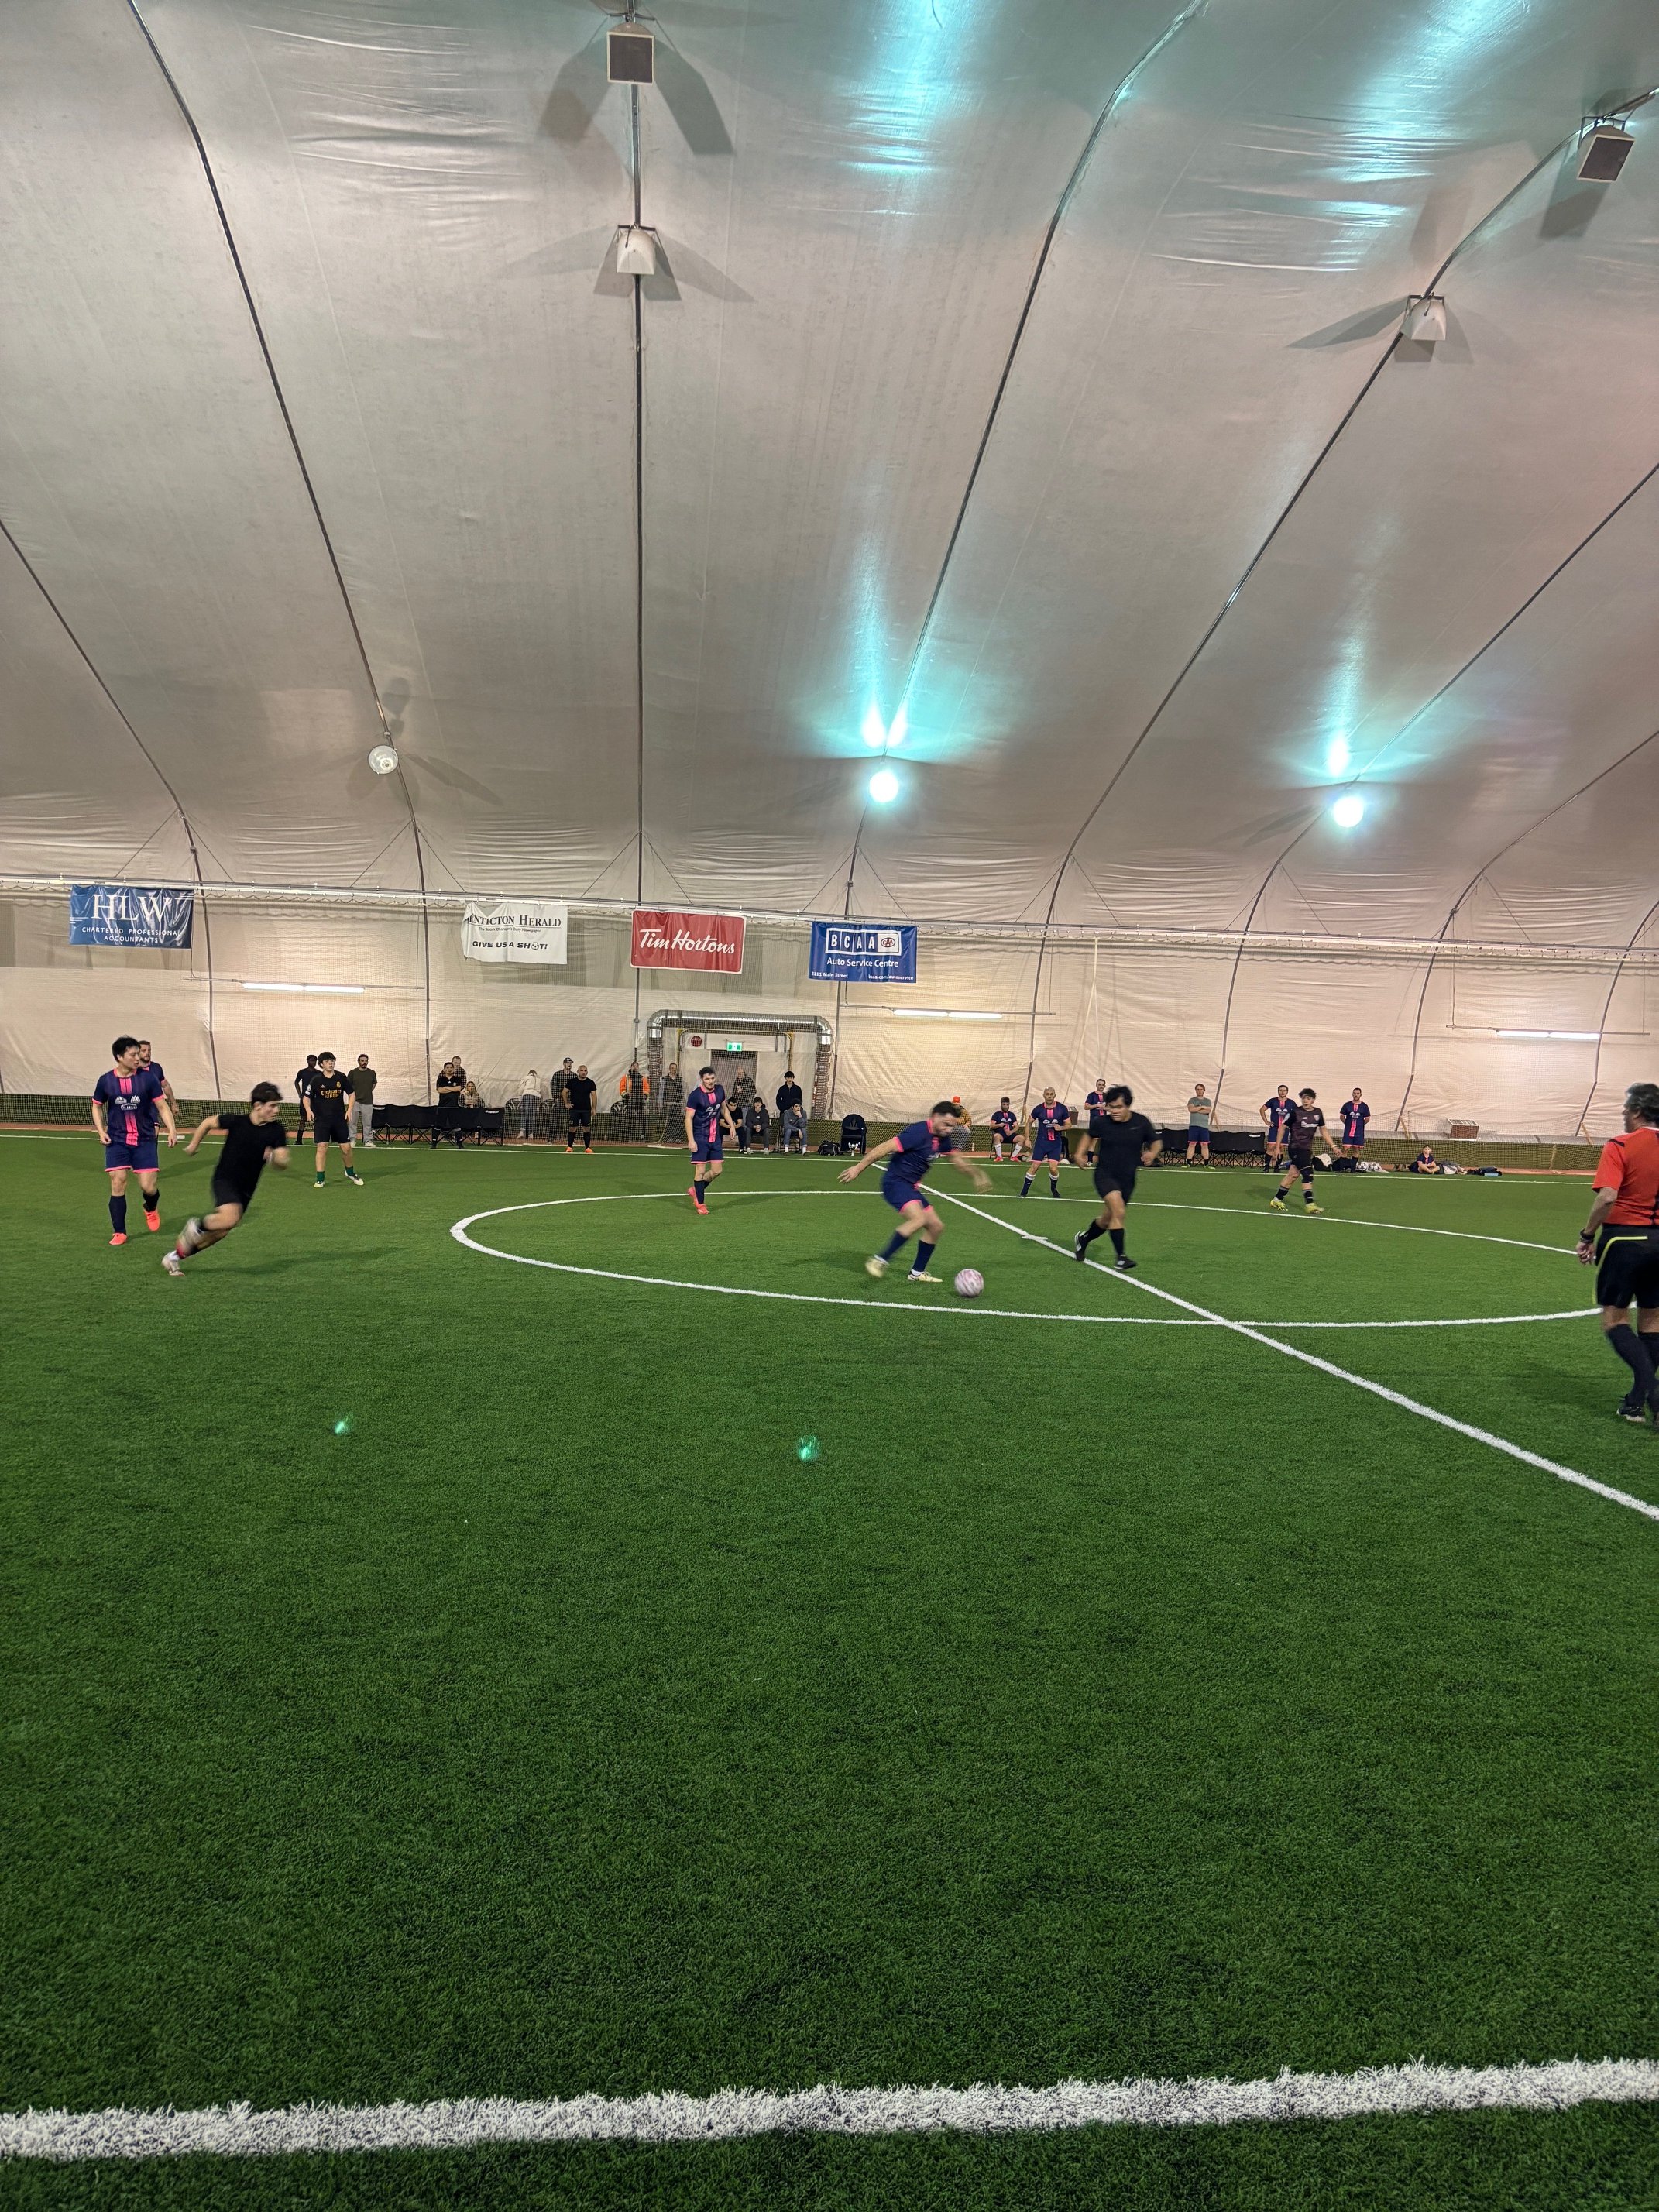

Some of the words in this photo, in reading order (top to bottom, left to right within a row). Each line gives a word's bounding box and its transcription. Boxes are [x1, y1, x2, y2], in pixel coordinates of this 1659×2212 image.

[91, 894, 172, 922] HLW
[465, 914, 514, 926] ENTICTON
[519, 915, 562, 927] HERALD
[129, 928, 182, 937] PROFESSIONAL
[639, 929, 669, 950] Tim
[672, 929, 735, 954] Hortons
[831, 934, 875, 949] BCAA
[826, 957, 845, 966] Auto
[847, 958, 873, 967] Service
[874, 959, 899, 967] Centre
